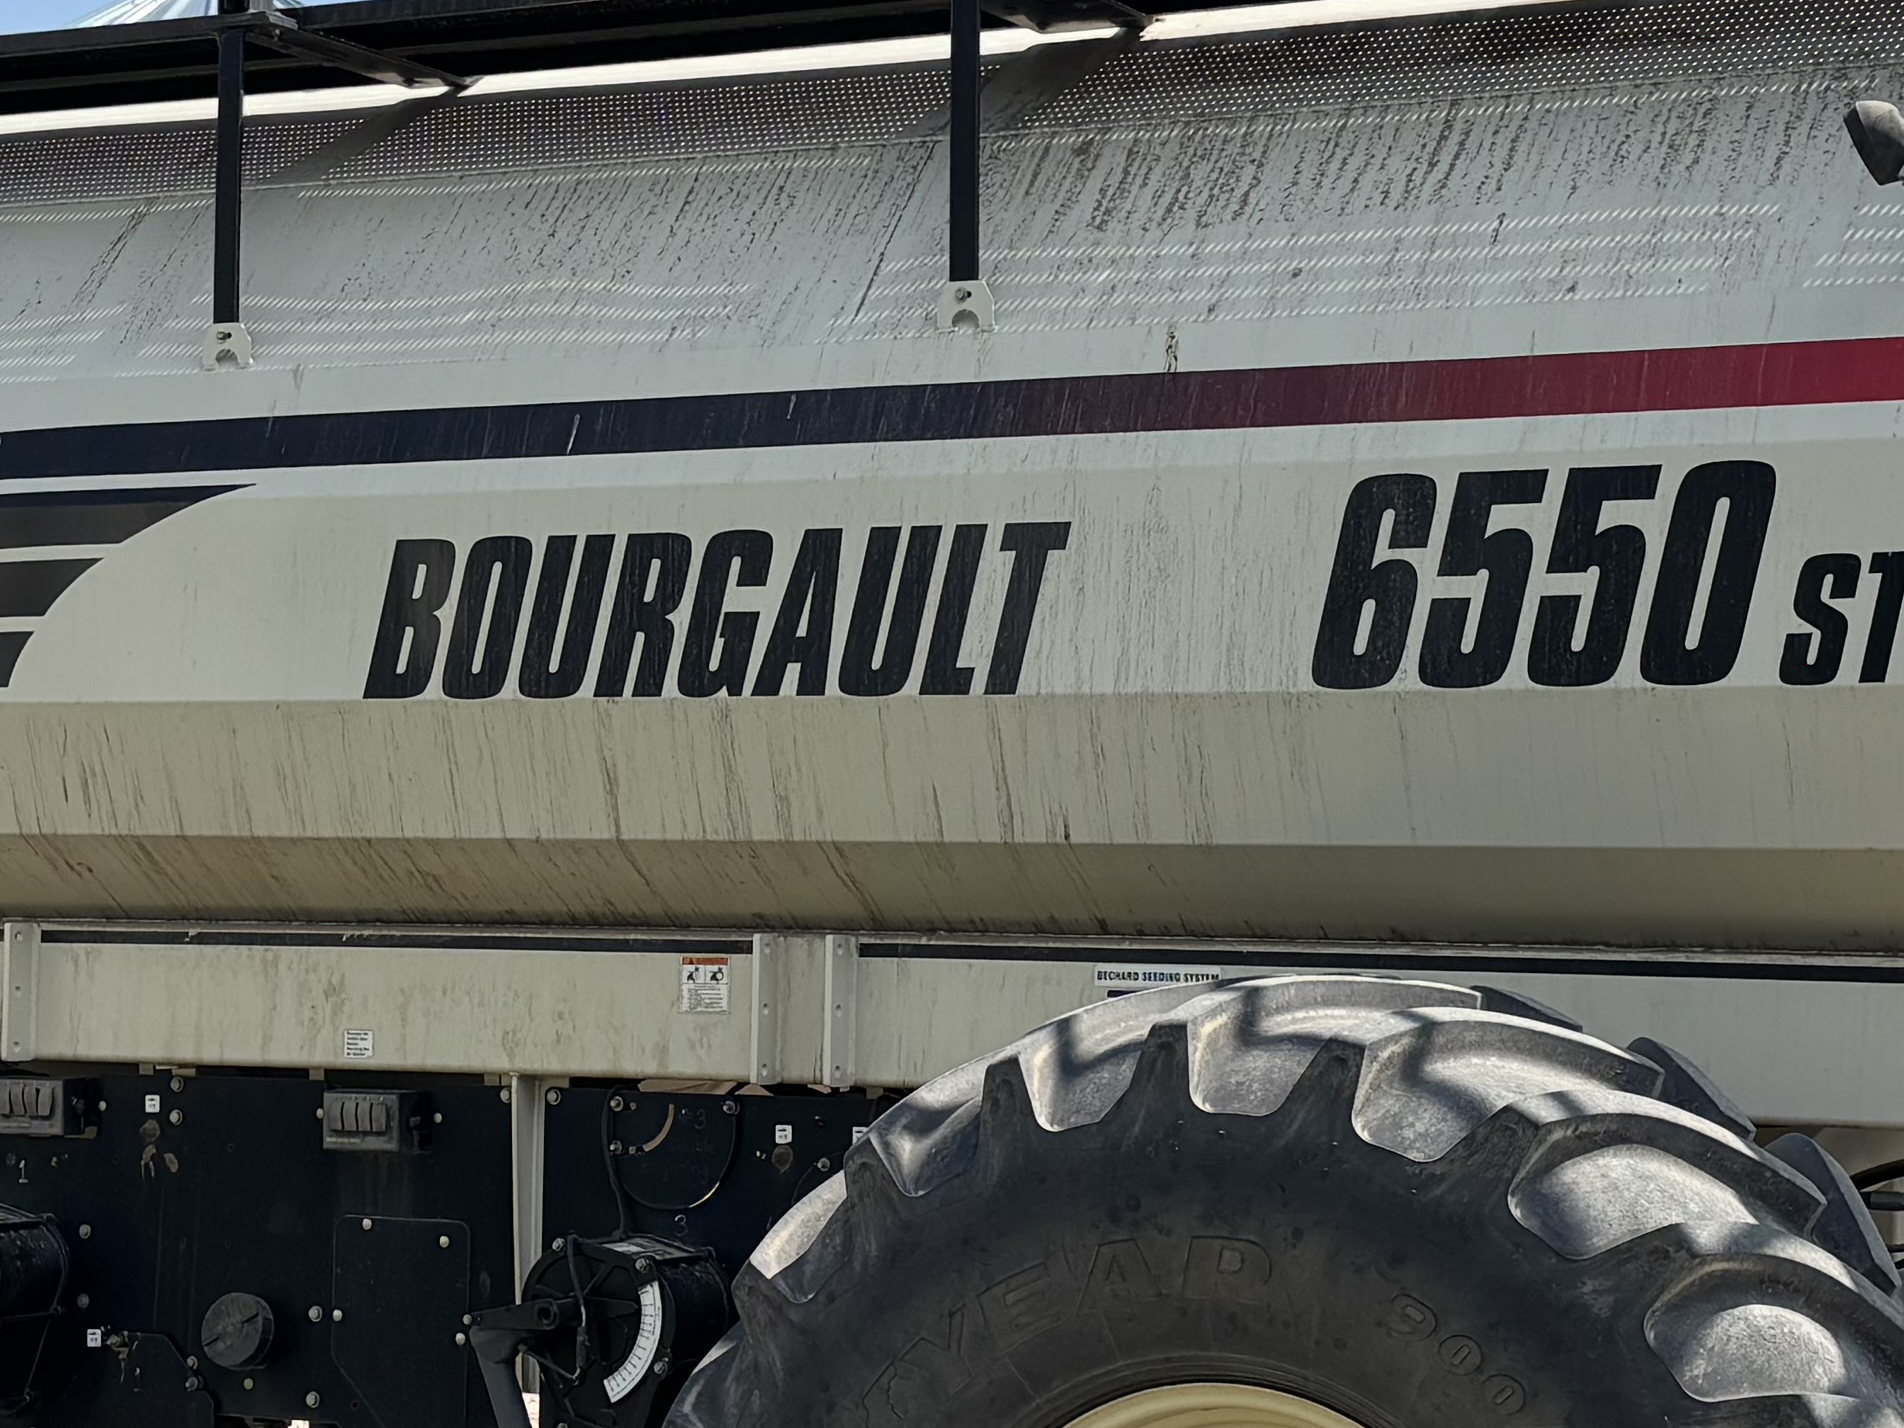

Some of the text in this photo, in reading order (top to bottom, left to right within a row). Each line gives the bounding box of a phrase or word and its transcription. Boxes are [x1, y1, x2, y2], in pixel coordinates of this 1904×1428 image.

[362, 520, 1071, 701] BOURGAULT
[1316, 459, 1776, 688] 6550
[1142, 971, 1181, 983] SEEDING
